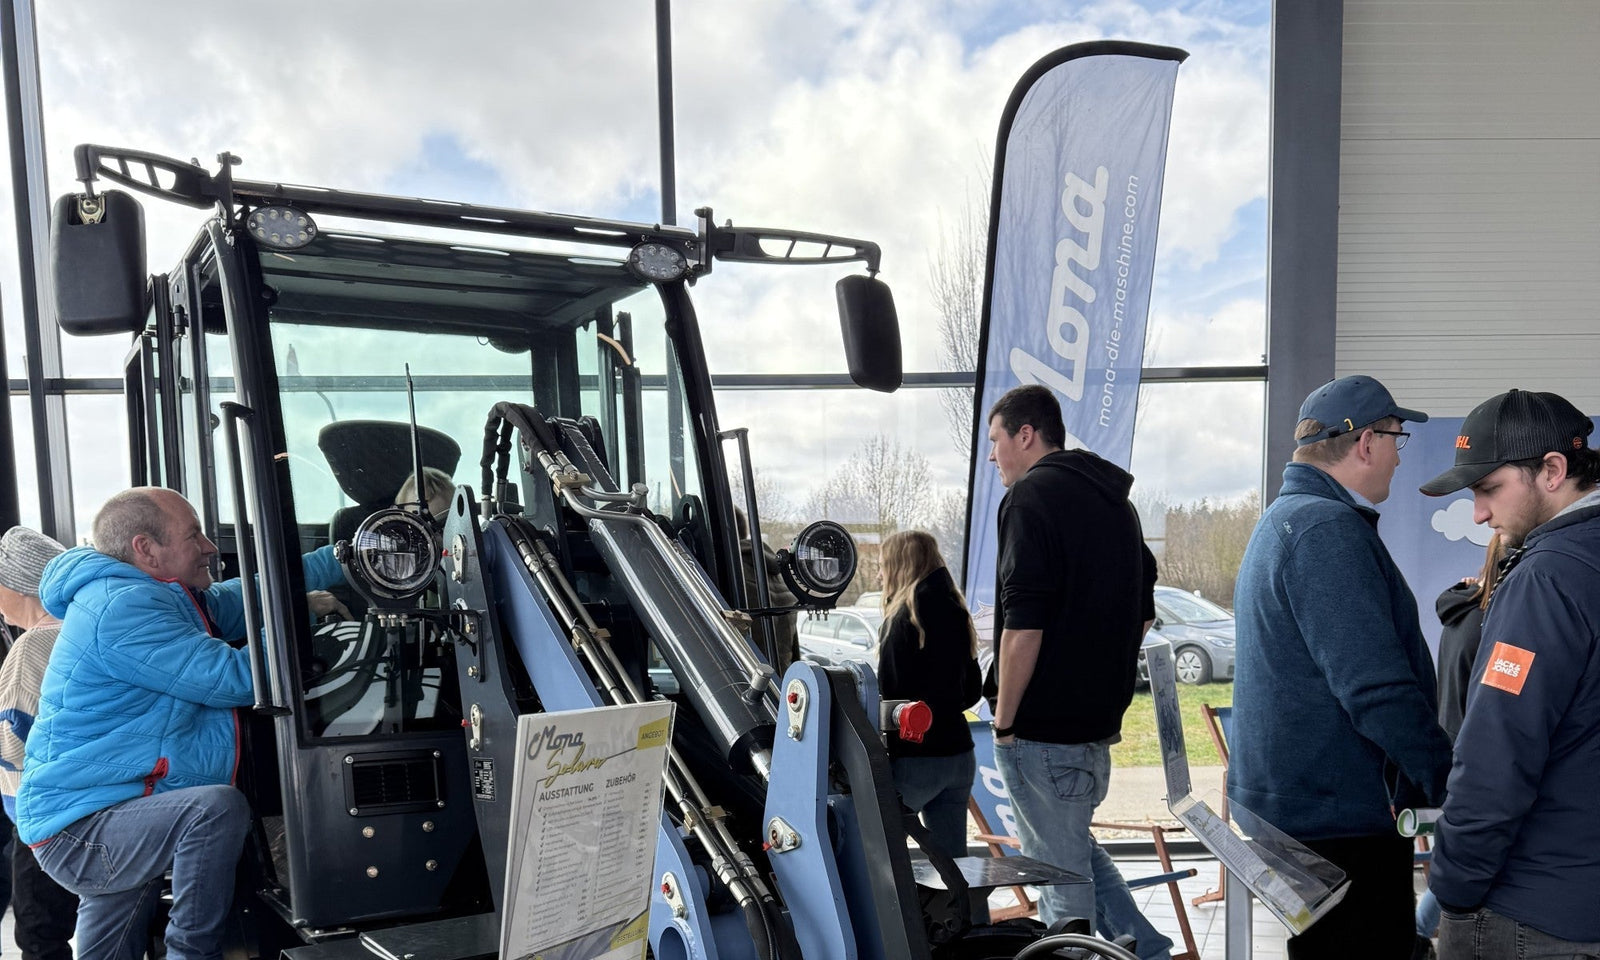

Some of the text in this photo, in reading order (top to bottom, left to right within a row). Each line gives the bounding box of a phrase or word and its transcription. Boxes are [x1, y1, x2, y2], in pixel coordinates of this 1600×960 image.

[1099, 174, 1138, 427] mona-die-maschine.com
[1492, 664, 1520, 678] JONES
[1494, 657, 1521, 672] JACK&
[527, 724, 585, 760] Mona
[640, 729, 665, 741] ANGEBOT
[605, 772, 637, 788] ZUBEHÖR
[538, 782, 595, 802] AUSSTATTUNG
